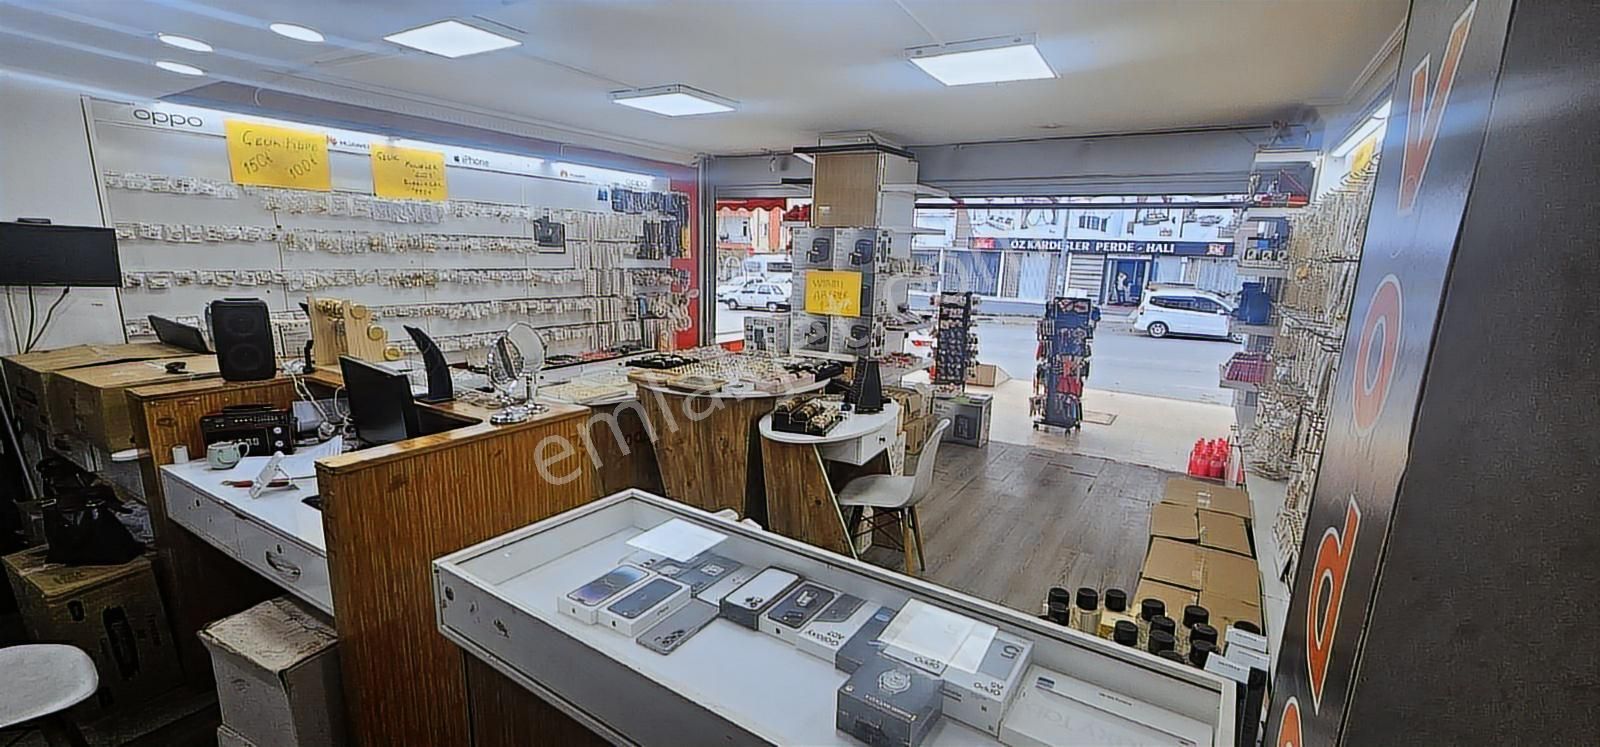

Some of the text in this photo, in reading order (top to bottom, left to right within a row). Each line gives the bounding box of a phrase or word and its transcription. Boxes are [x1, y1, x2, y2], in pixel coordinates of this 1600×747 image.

[462, 157, 489, 167] iPhone
[1095, 241, 1136, 252] PERDE
[1146, 243, 1175, 253] HALI
